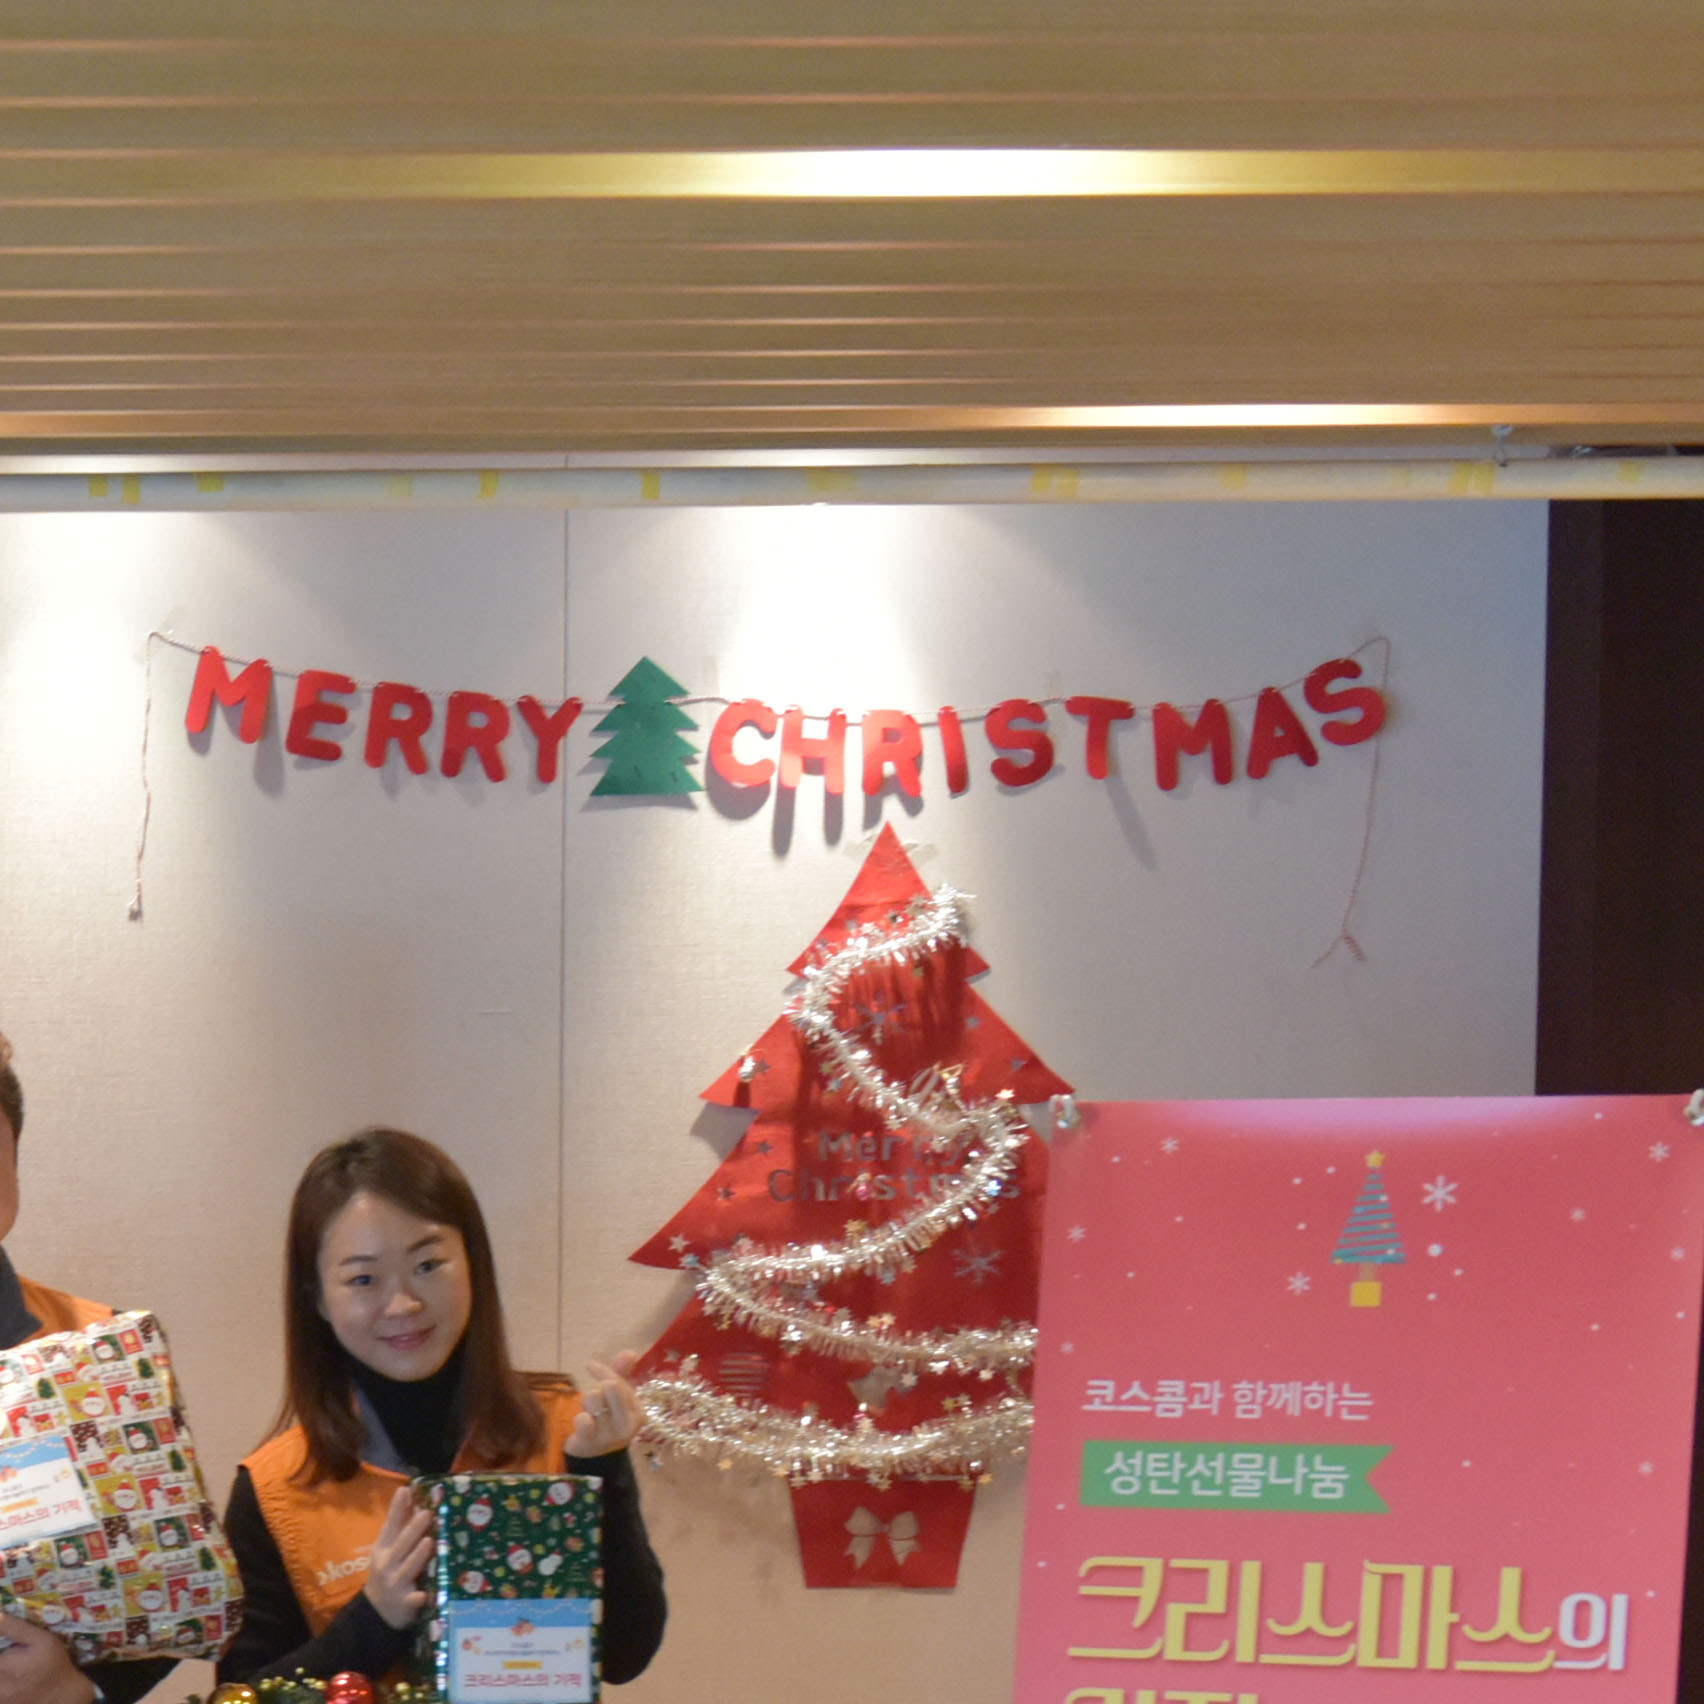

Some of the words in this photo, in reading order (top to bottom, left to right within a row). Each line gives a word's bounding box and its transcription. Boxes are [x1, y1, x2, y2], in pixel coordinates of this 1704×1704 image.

[185, 645, 582, 786] MERRY
[708, 657, 1387, 797] CHRISTMAS
[1080, 1380, 1223, 1418] 코스콤과
[1232, 1380, 1373, 1420] 함께하는
[1104, 1450, 1350, 1499] 성탄선물나눔
[1066, 1554, 1629, 1673] 크리스마스의
